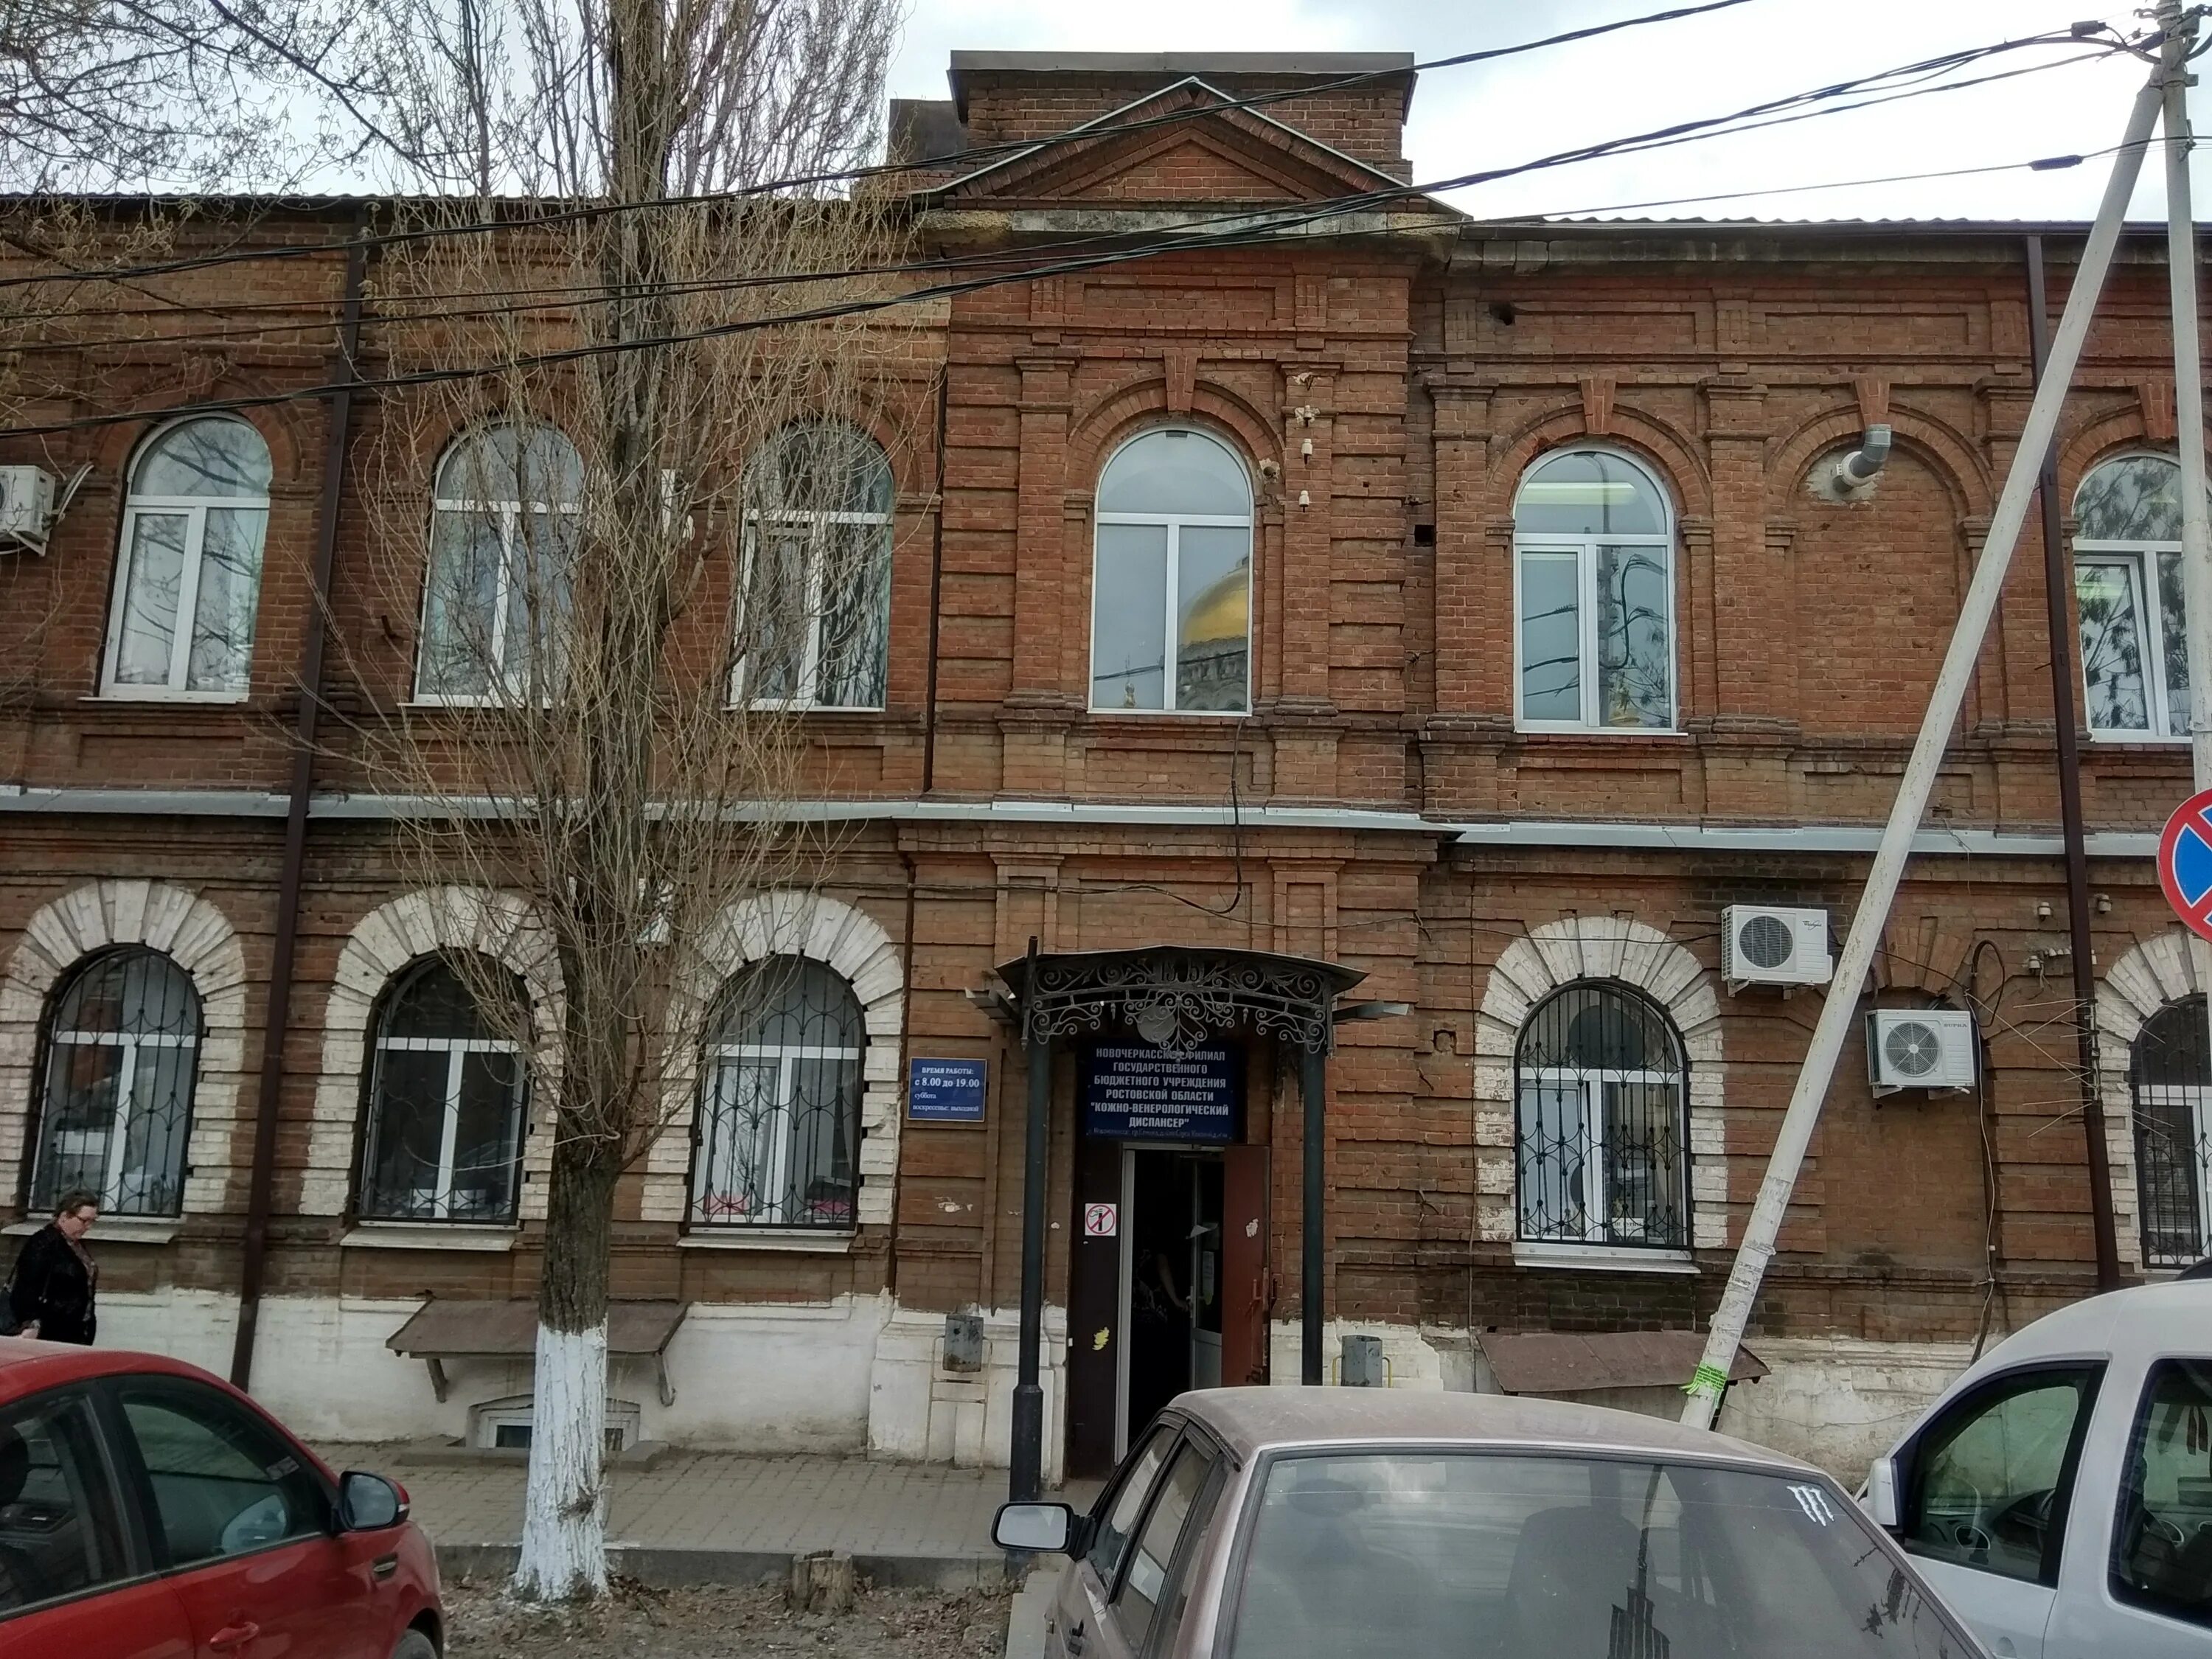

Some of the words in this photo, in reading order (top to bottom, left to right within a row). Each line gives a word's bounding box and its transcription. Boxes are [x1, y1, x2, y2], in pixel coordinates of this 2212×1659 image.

[1096, 1048, 1182, 1060] НОВОЧЕРКАССК
[1186, 1050, 1225, 1061] ФИЛИАЛ
[1113, 1062, 1208, 1074] ГОСУДАРСТВЕННОГО
[922, 1077, 941, 1087] 8.00
[956, 1078, 980, 1088] 19.00
[1093, 1075, 1160, 1086] БЮДЖЕТНОГО
[1163, 1077, 1227, 1088] УЧРЕЖДЕНИЯ
[914, 1091, 937, 1100] суббота
[1105, 1088, 1168, 1100] РОСТОВСКОЙ
[1171, 1091, 1214, 1102] ОБЛАСТИ
[1091, 1102, 1229, 1116] "КОЖНО-ВЕНЕРОЛОГИЧЕСКИЙ
[1128, 1116, 1190, 1129] ДИСПАНСЕР"
